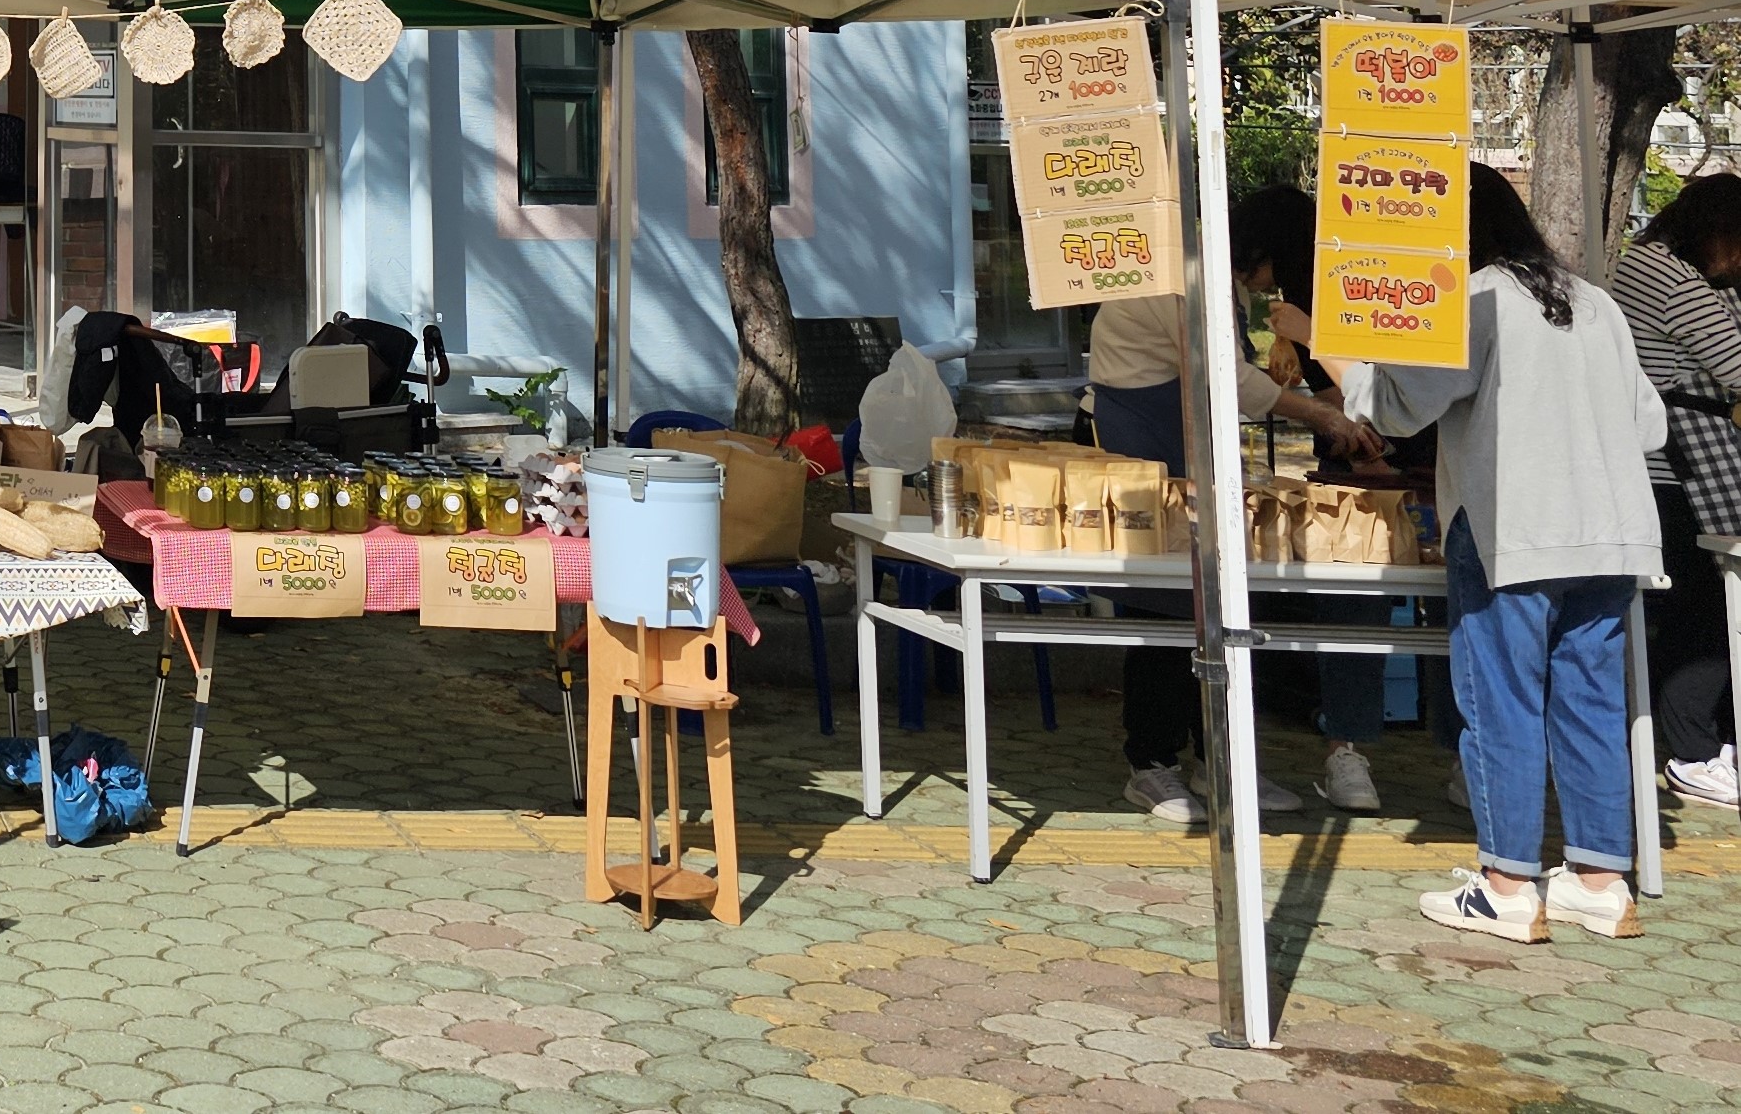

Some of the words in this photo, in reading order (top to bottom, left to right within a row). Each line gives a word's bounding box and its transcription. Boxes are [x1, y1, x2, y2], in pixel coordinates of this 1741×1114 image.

[1020, 49, 1062, 84] 구운
[1069, 47, 1128, 77] 계란
[1356, 47, 1437, 83] 떡볶이
[1044, 141, 1144, 180] 다래청
[1338, 164, 1394, 187] 고구마
[1399, 169, 1448, 195] 맛탕
[1060, 228, 1151, 270] 청귤청
[1343, 276, 1435, 309] 빠삭이
[256, 545, 346, 579] 다래청
[446, 547, 527, 584] 청귤청
